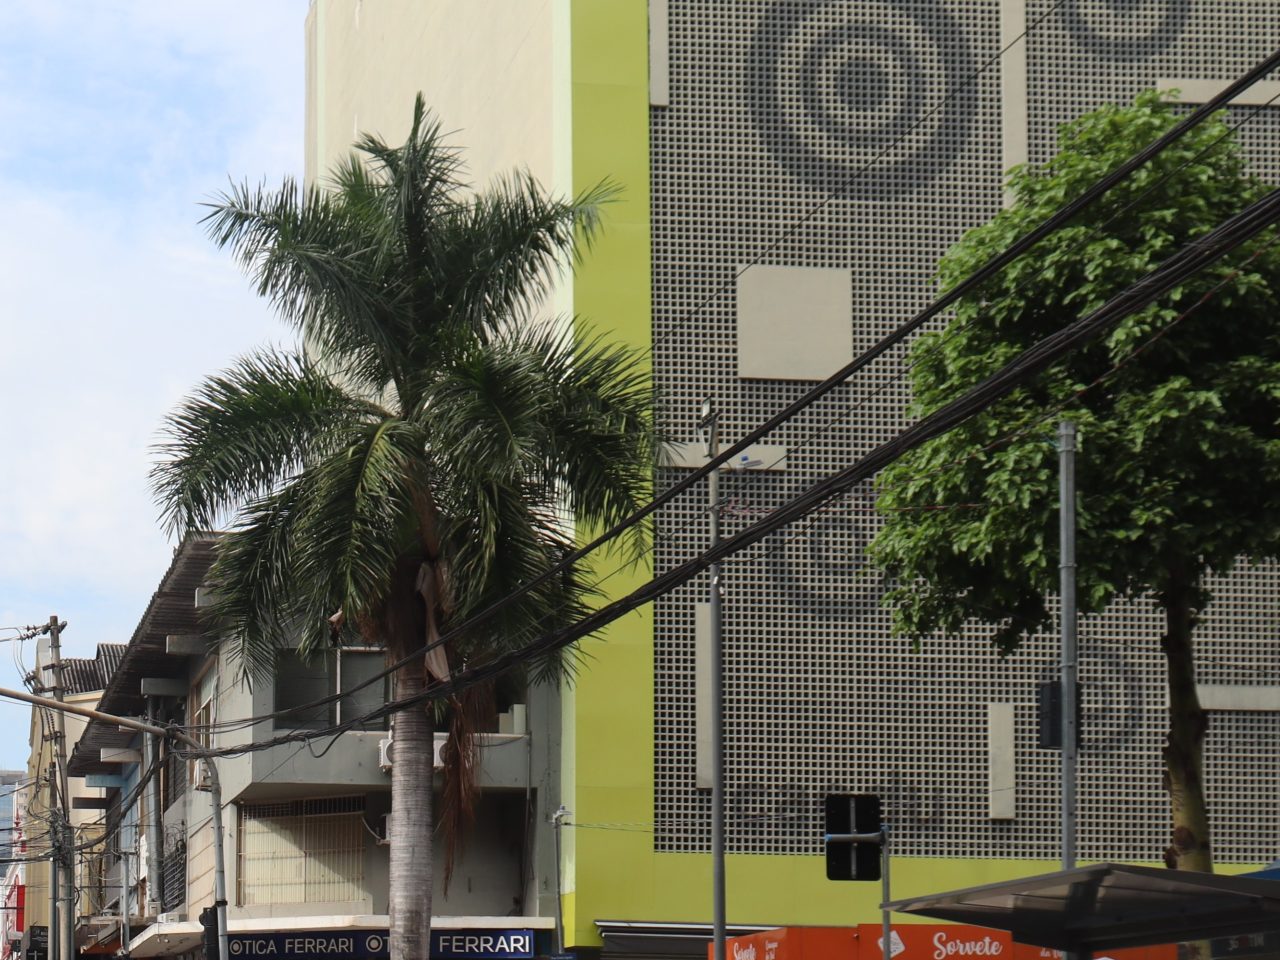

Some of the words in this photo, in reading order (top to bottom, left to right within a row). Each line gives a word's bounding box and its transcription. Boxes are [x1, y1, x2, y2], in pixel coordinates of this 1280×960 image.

[285, 937, 353, 954] FERRARI
[439, 935, 530, 953] FERRARI
[933, 931, 1003, 960] Sorvete
